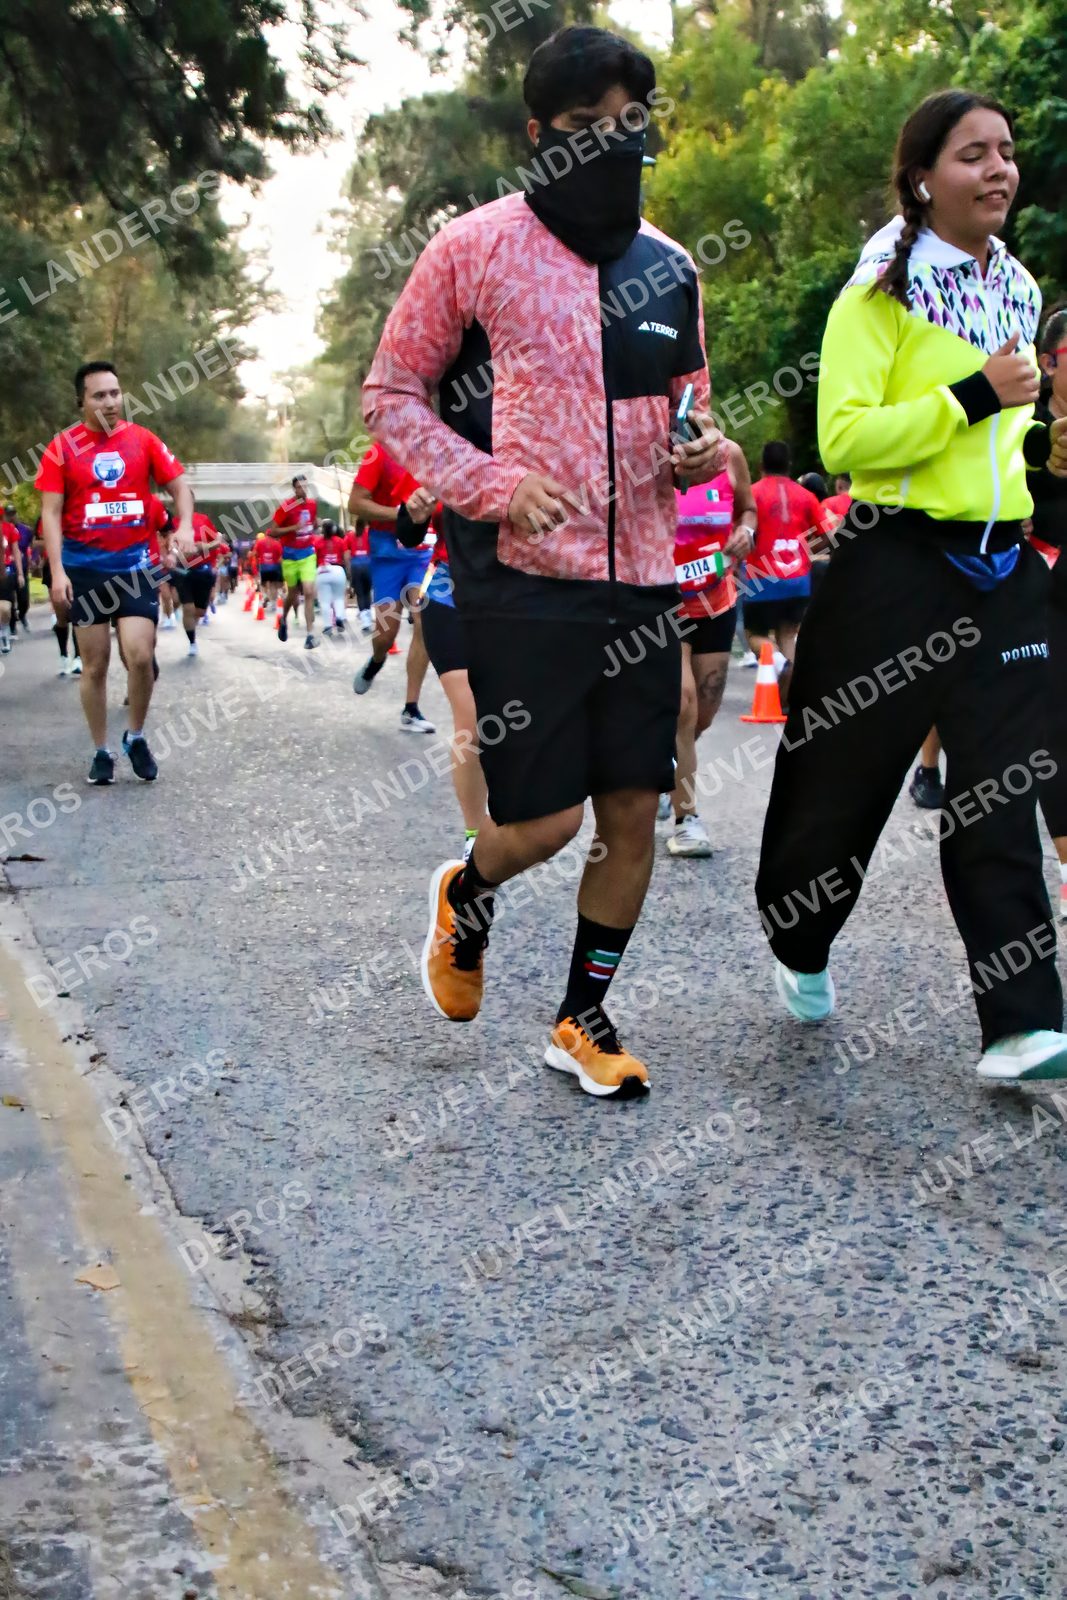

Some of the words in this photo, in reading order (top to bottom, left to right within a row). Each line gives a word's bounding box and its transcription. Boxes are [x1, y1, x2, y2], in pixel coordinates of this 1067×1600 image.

[650, 321, 678, 339] TERREX
[105, 502, 127, 514] 1526
[683, 559, 710, 579] 2114
